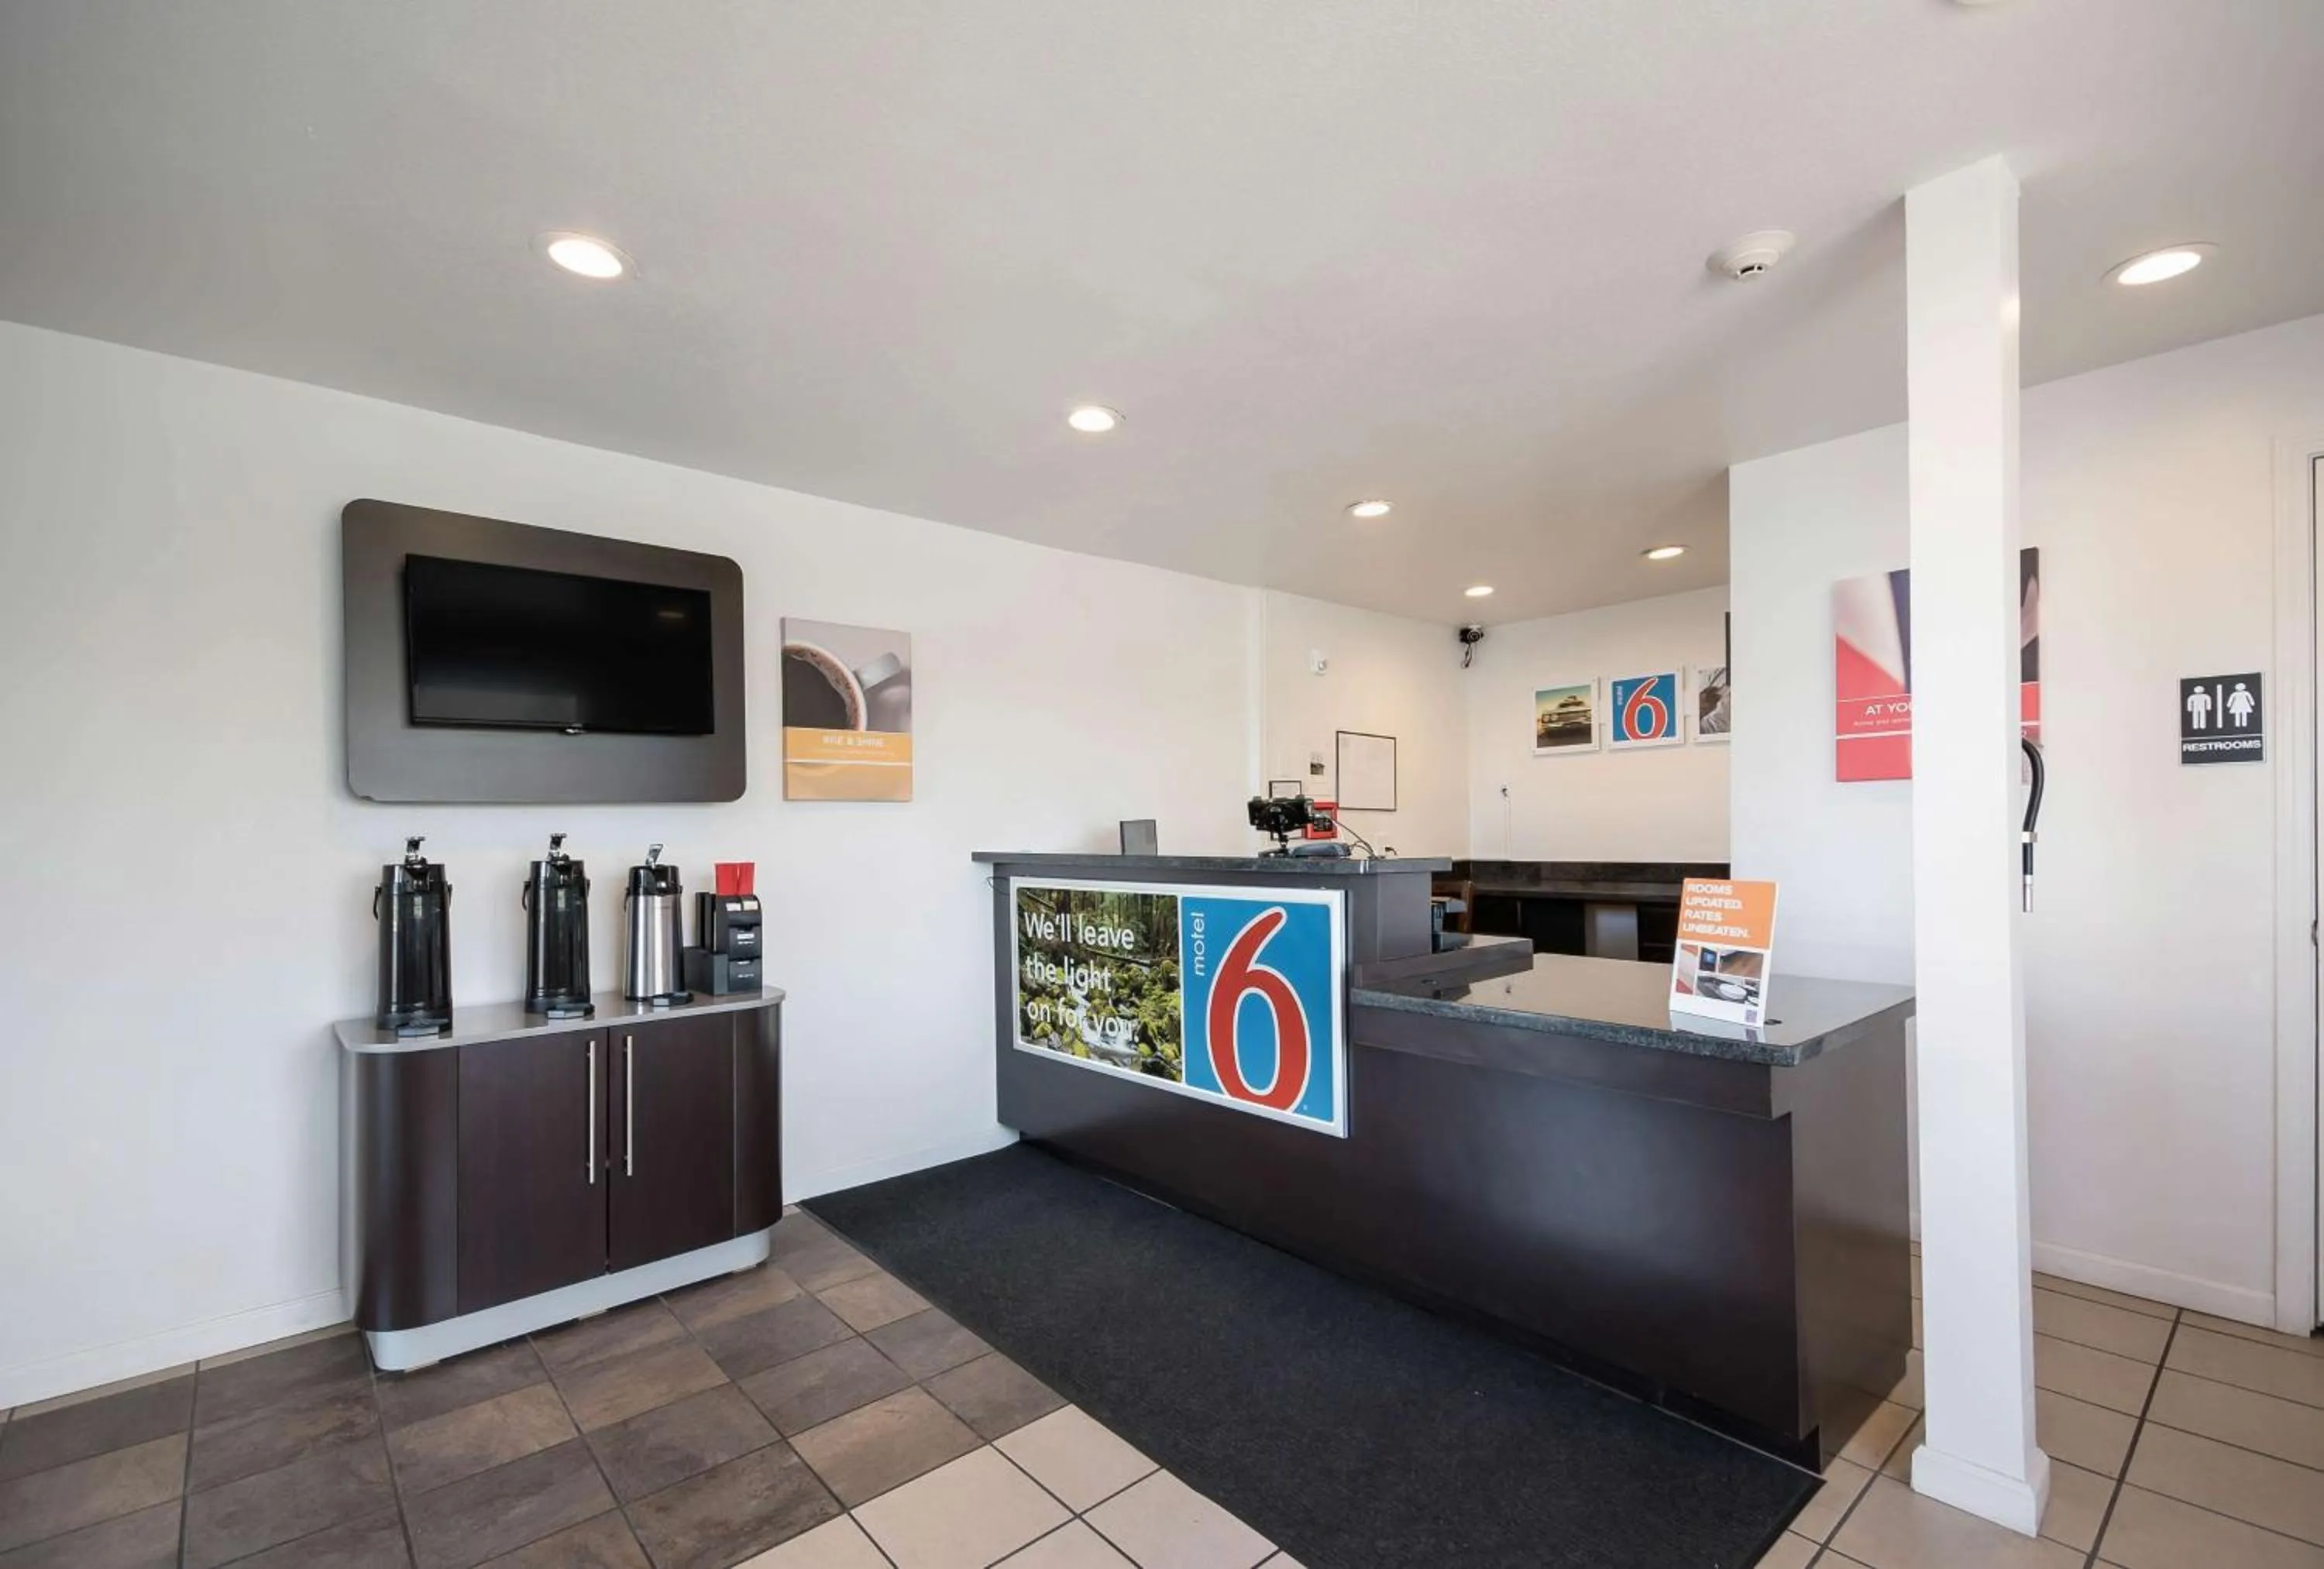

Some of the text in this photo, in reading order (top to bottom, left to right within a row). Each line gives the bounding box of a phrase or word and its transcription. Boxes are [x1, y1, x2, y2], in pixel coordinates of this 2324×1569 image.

[1622, 677, 1668, 741] 6
[1864, 702, 1911, 716] AT YO
[2182, 740, 2262, 752] RESTROOMS
[1685, 884, 1734, 895] ROOMS
[1024, 912, 1135, 950] We'll leave
[1684, 909, 1723, 922] RATES
[1191, 912, 1205, 977] motel
[1026, 952, 1112, 996] the light
[1026, 996, 1140, 1043] on for you.
[1205, 905, 1312, 1114] 6
